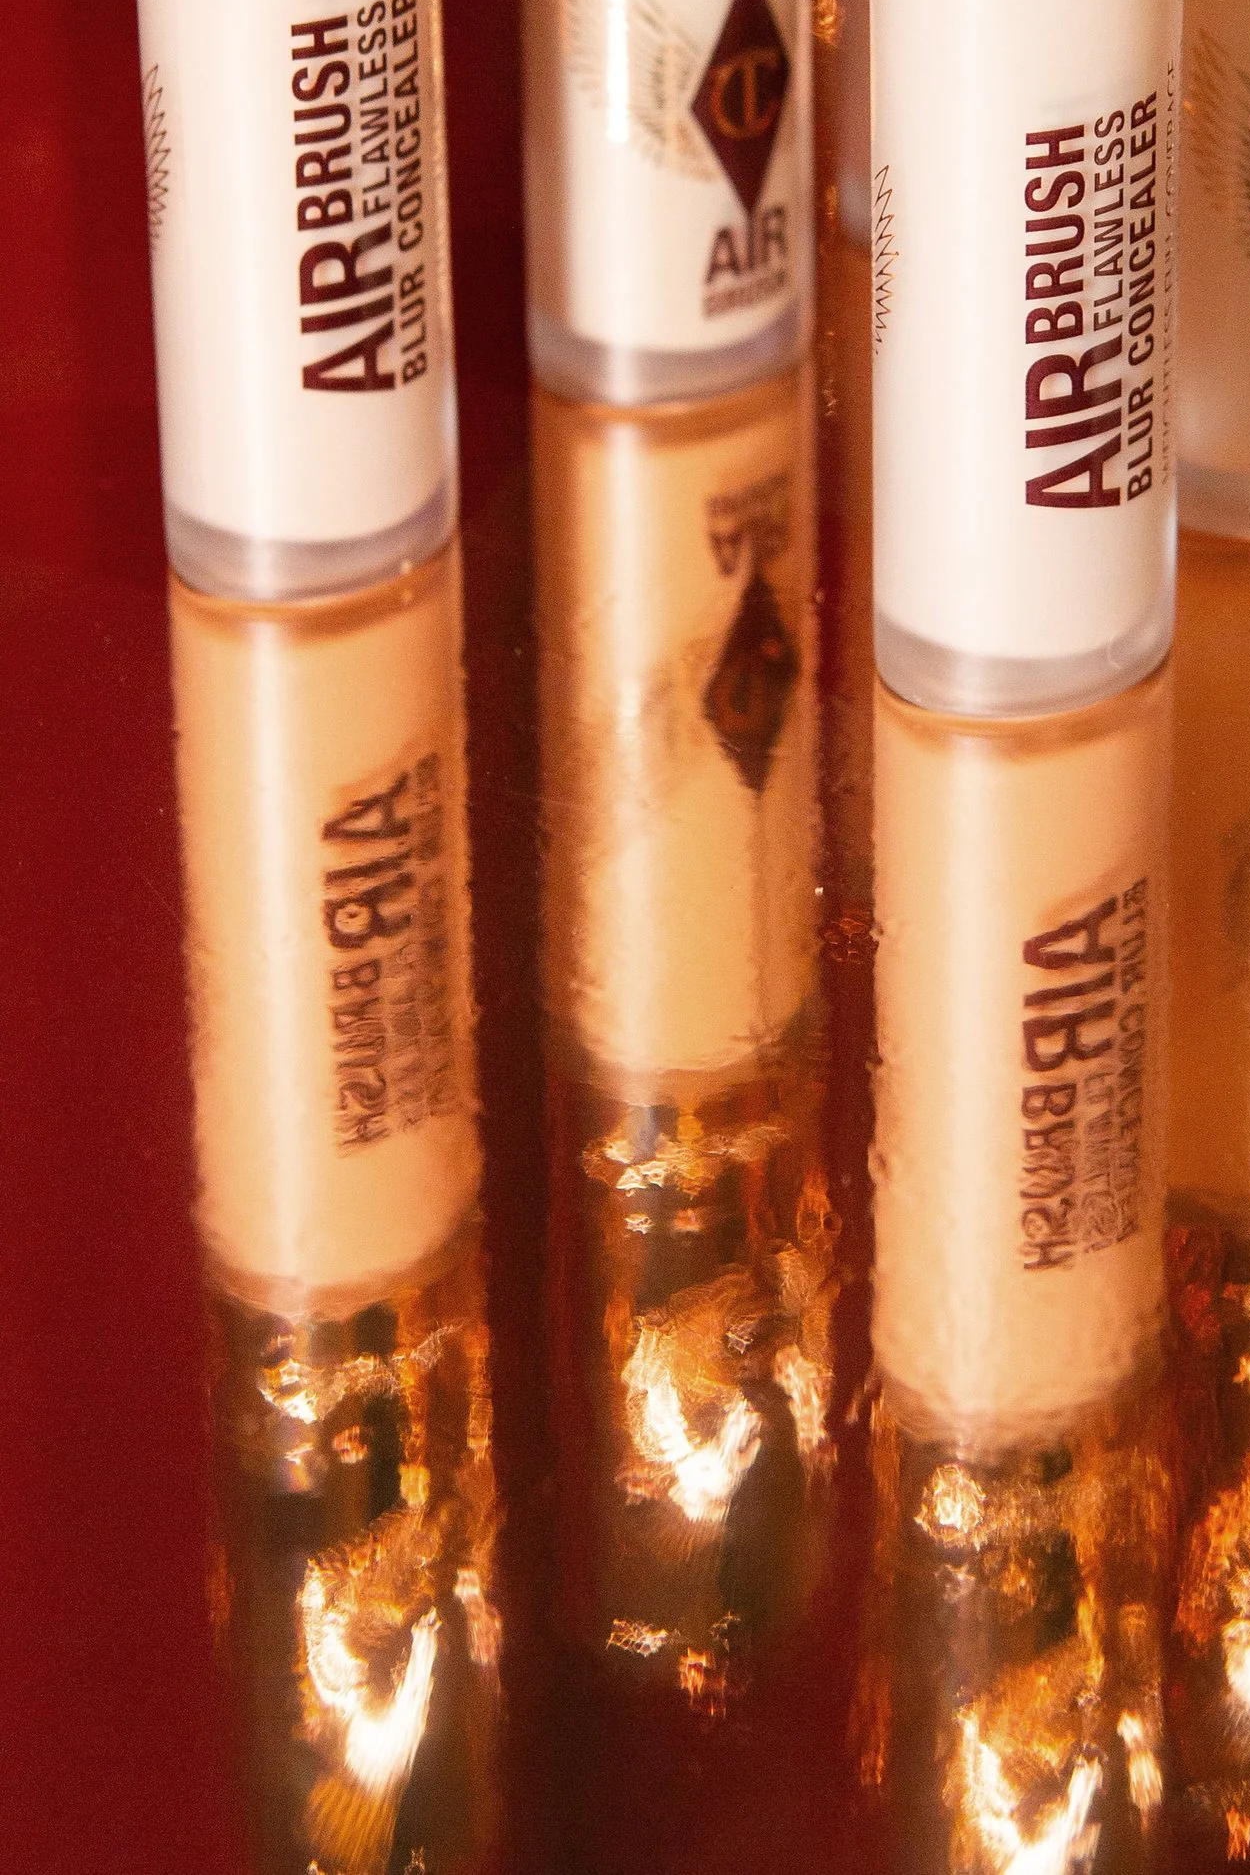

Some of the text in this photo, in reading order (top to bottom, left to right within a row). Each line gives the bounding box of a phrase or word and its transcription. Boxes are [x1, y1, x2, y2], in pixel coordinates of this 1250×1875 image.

[703, 205, 788, 287] AIR
[1093, 108, 1127, 333] FLAWLESS
[1126, 89, 1159, 503] BLUR CONCEALER
[399, 262, 427, 387] BLUR
